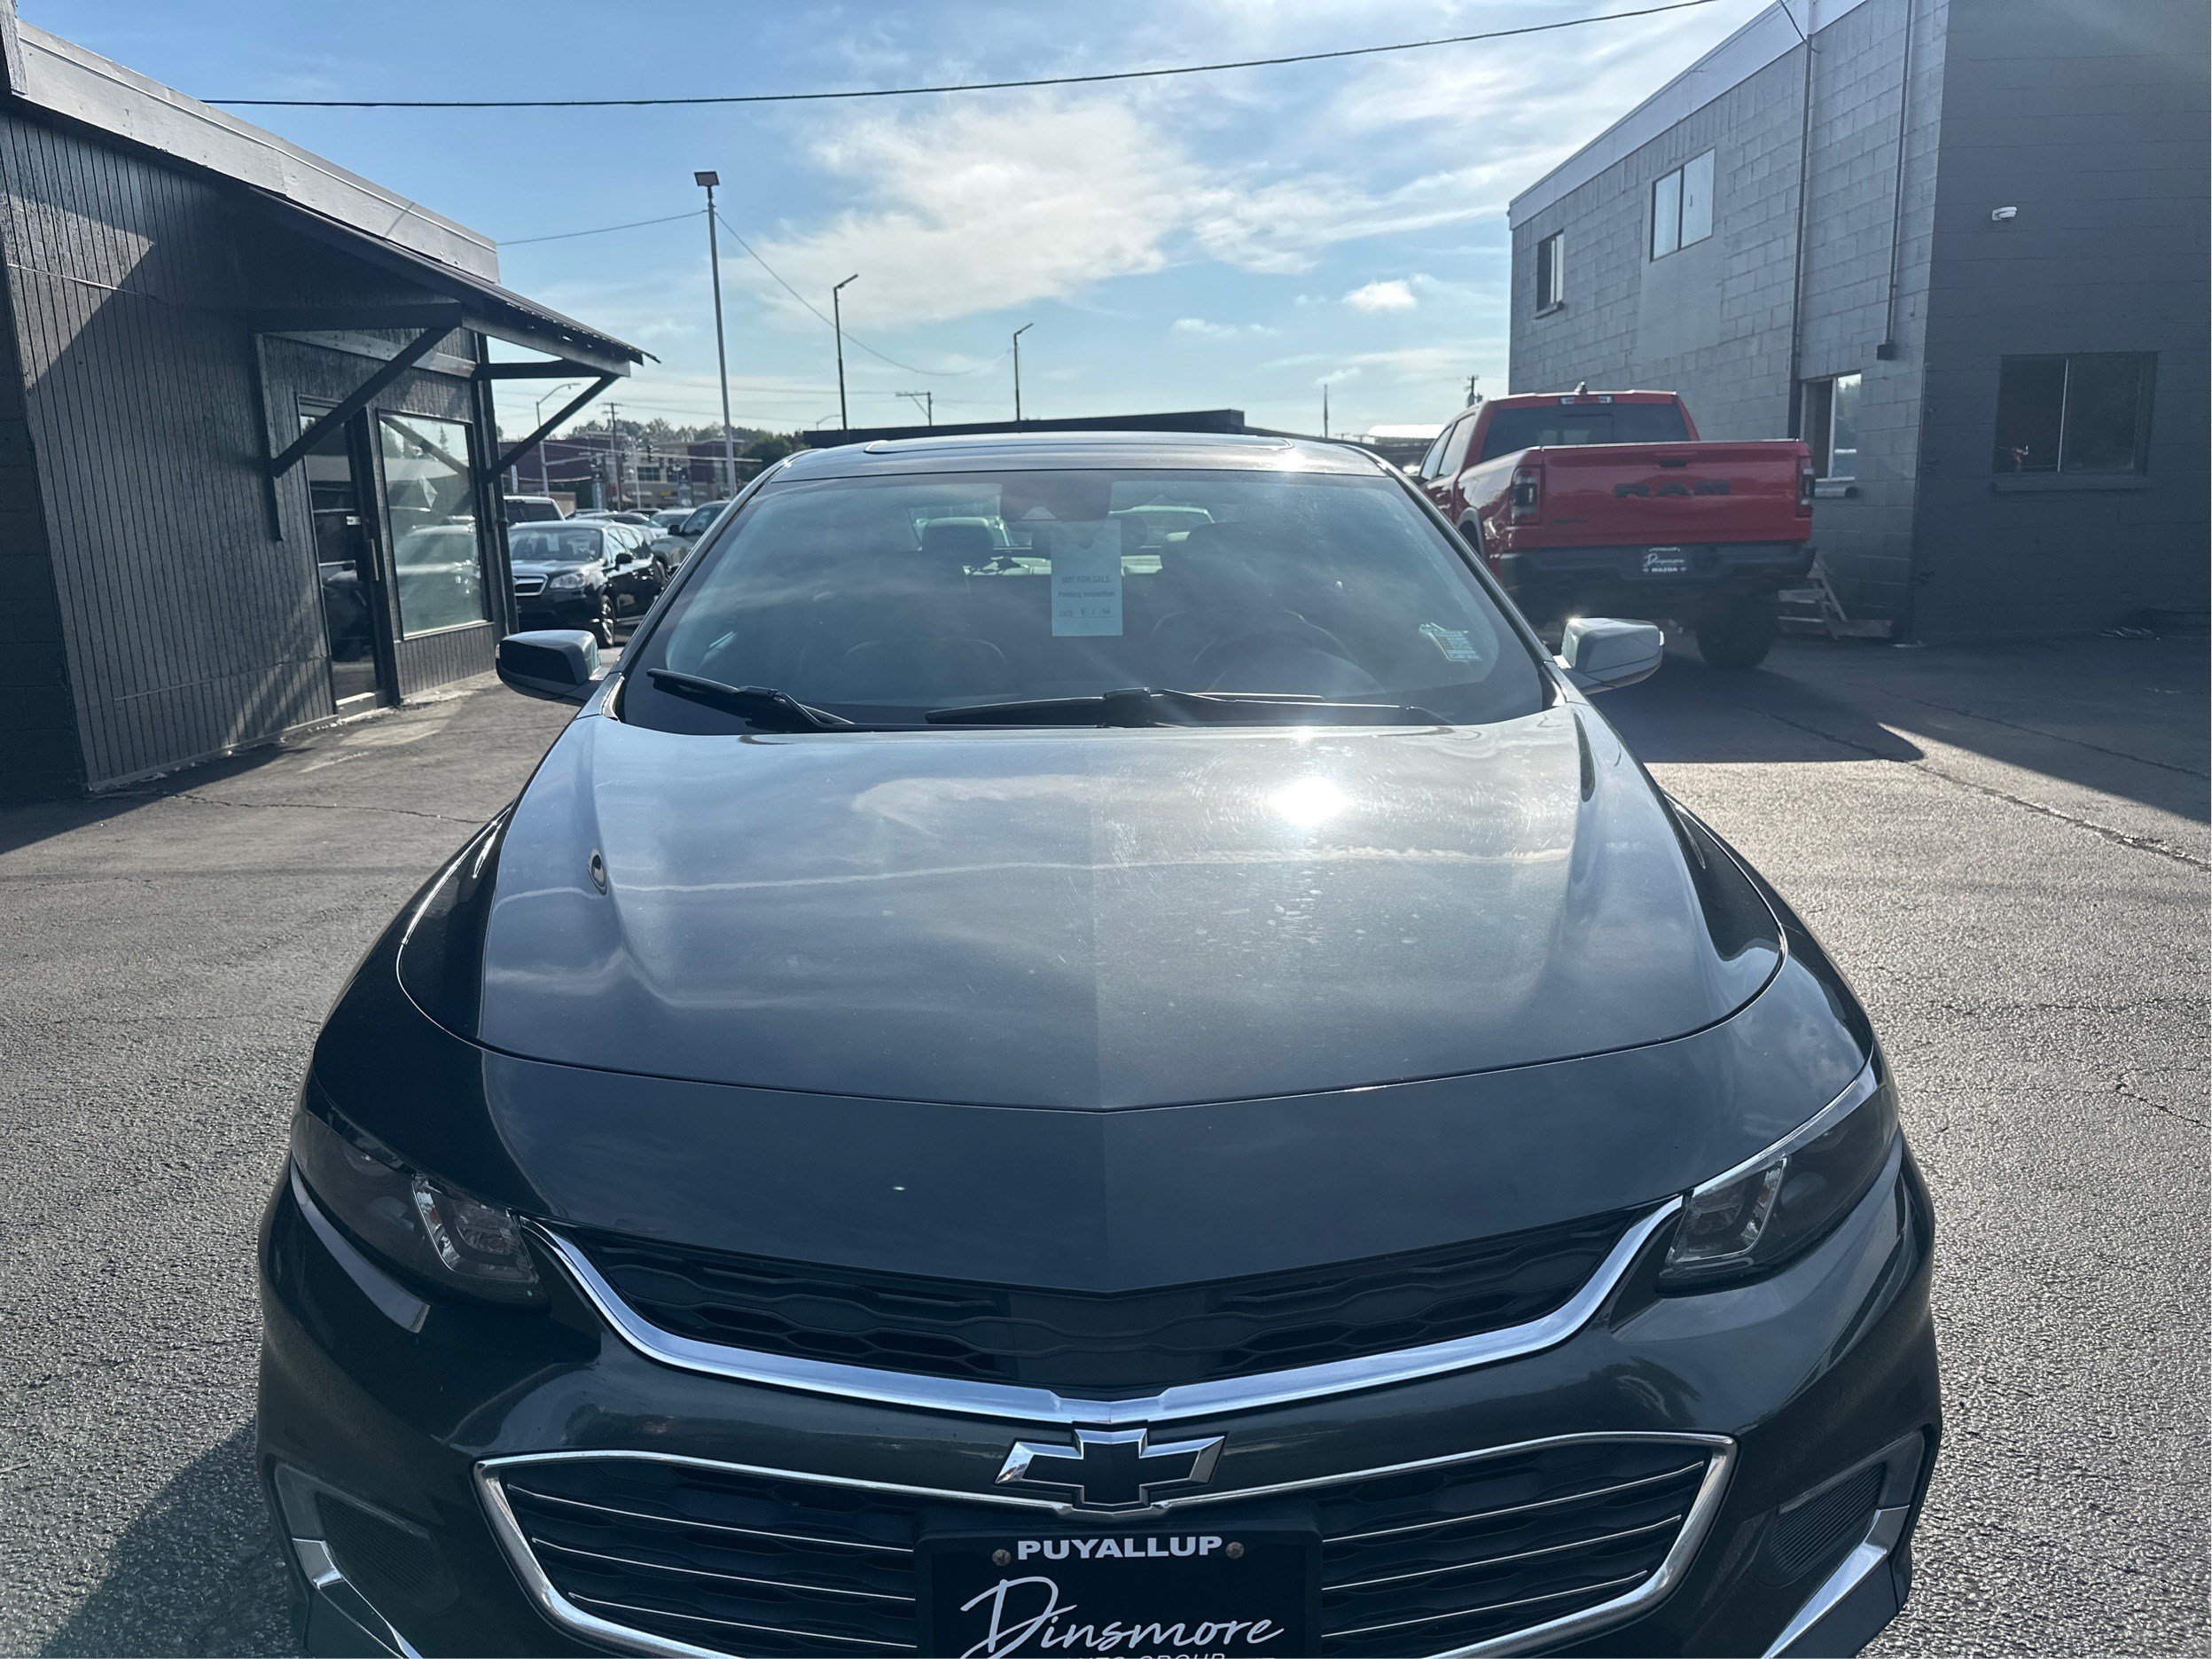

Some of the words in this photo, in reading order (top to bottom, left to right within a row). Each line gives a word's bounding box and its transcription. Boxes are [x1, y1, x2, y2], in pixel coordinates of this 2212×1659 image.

[1614, 481, 1731, 498] RAM
[1092, 575, 1111, 583] SALE
[1017, 1536, 1223, 1561] PUYALLUP
[960, 1576, 1285, 1659] Dinsmore
